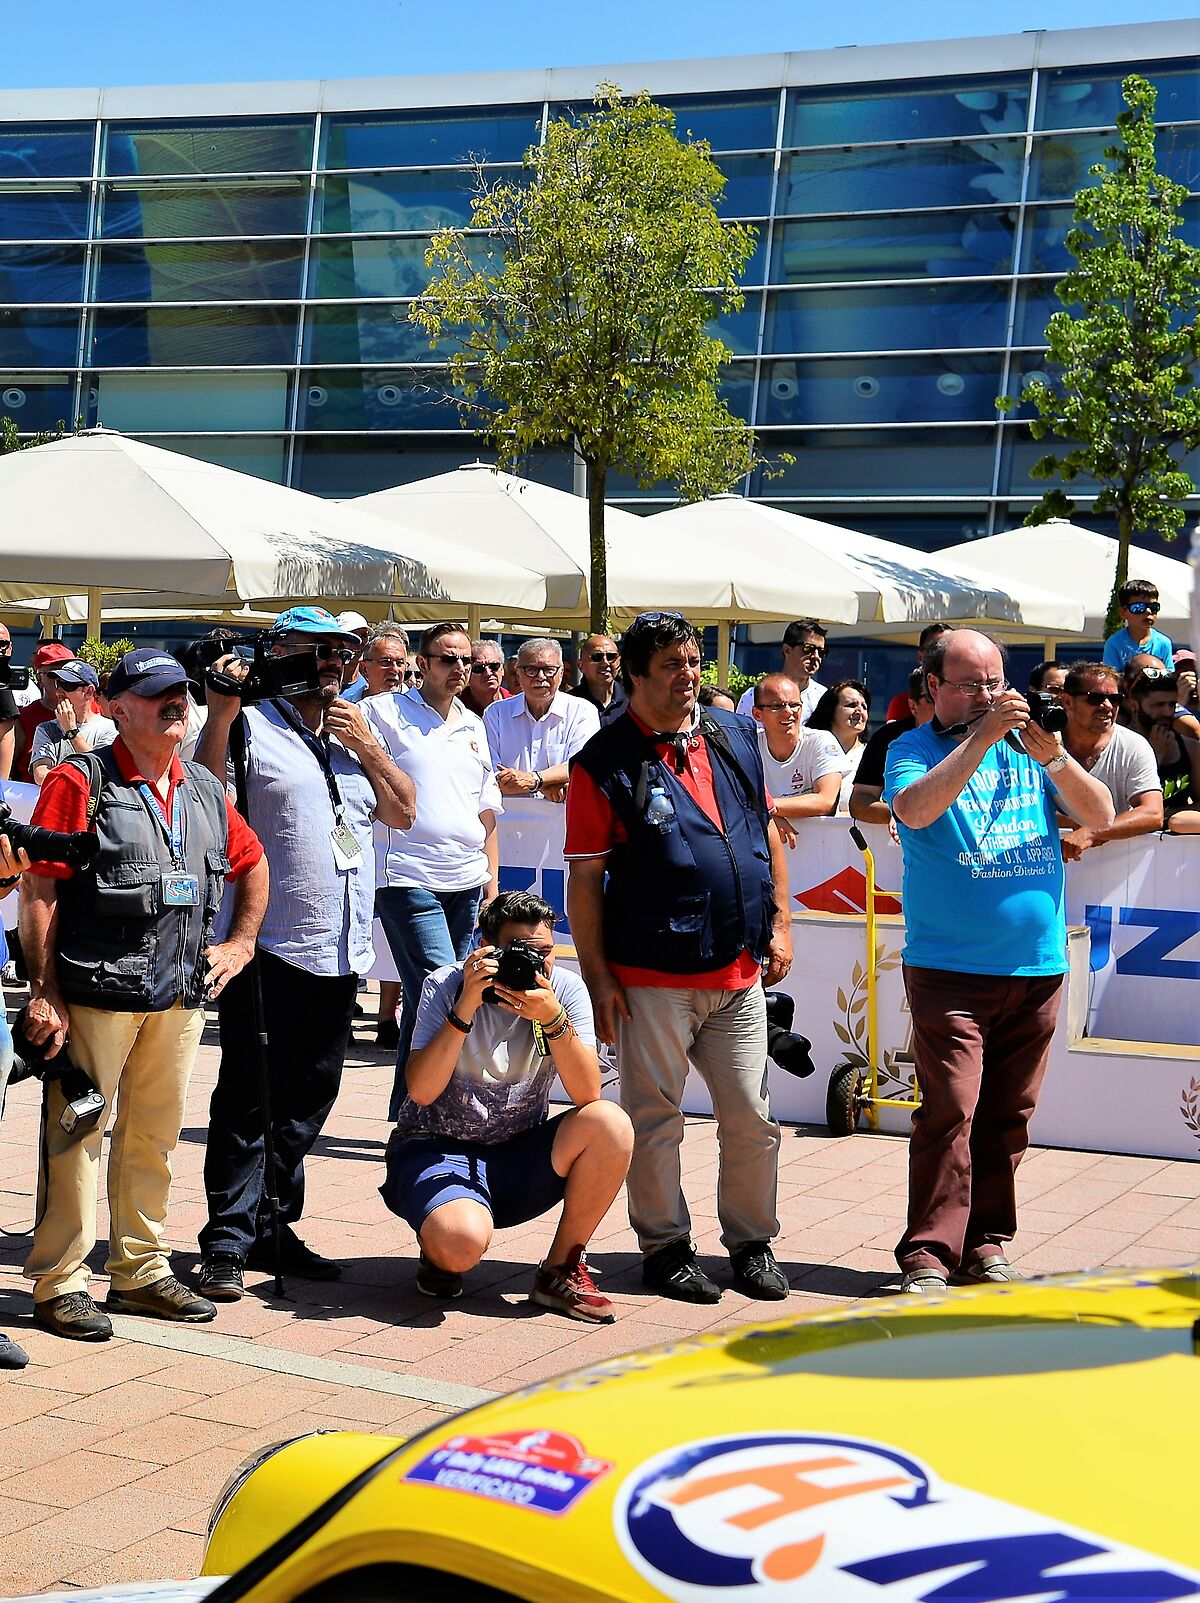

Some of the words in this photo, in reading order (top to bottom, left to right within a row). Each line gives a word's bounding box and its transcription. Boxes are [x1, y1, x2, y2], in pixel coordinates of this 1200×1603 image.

[973, 812, 1037, 836] London
[976, 834, 1024, 851] AUTHENTIC
[1023, 831, 1043, 848] AND
[958, 850, 1002, 866] ORIGINAL
[1003, 849, 1026, 865] U.K.
[1025, 846, 1057, 863] APPAREL
[971, 866, 1014, 879] Fashion
[1013, 864, 1046, 877] District
